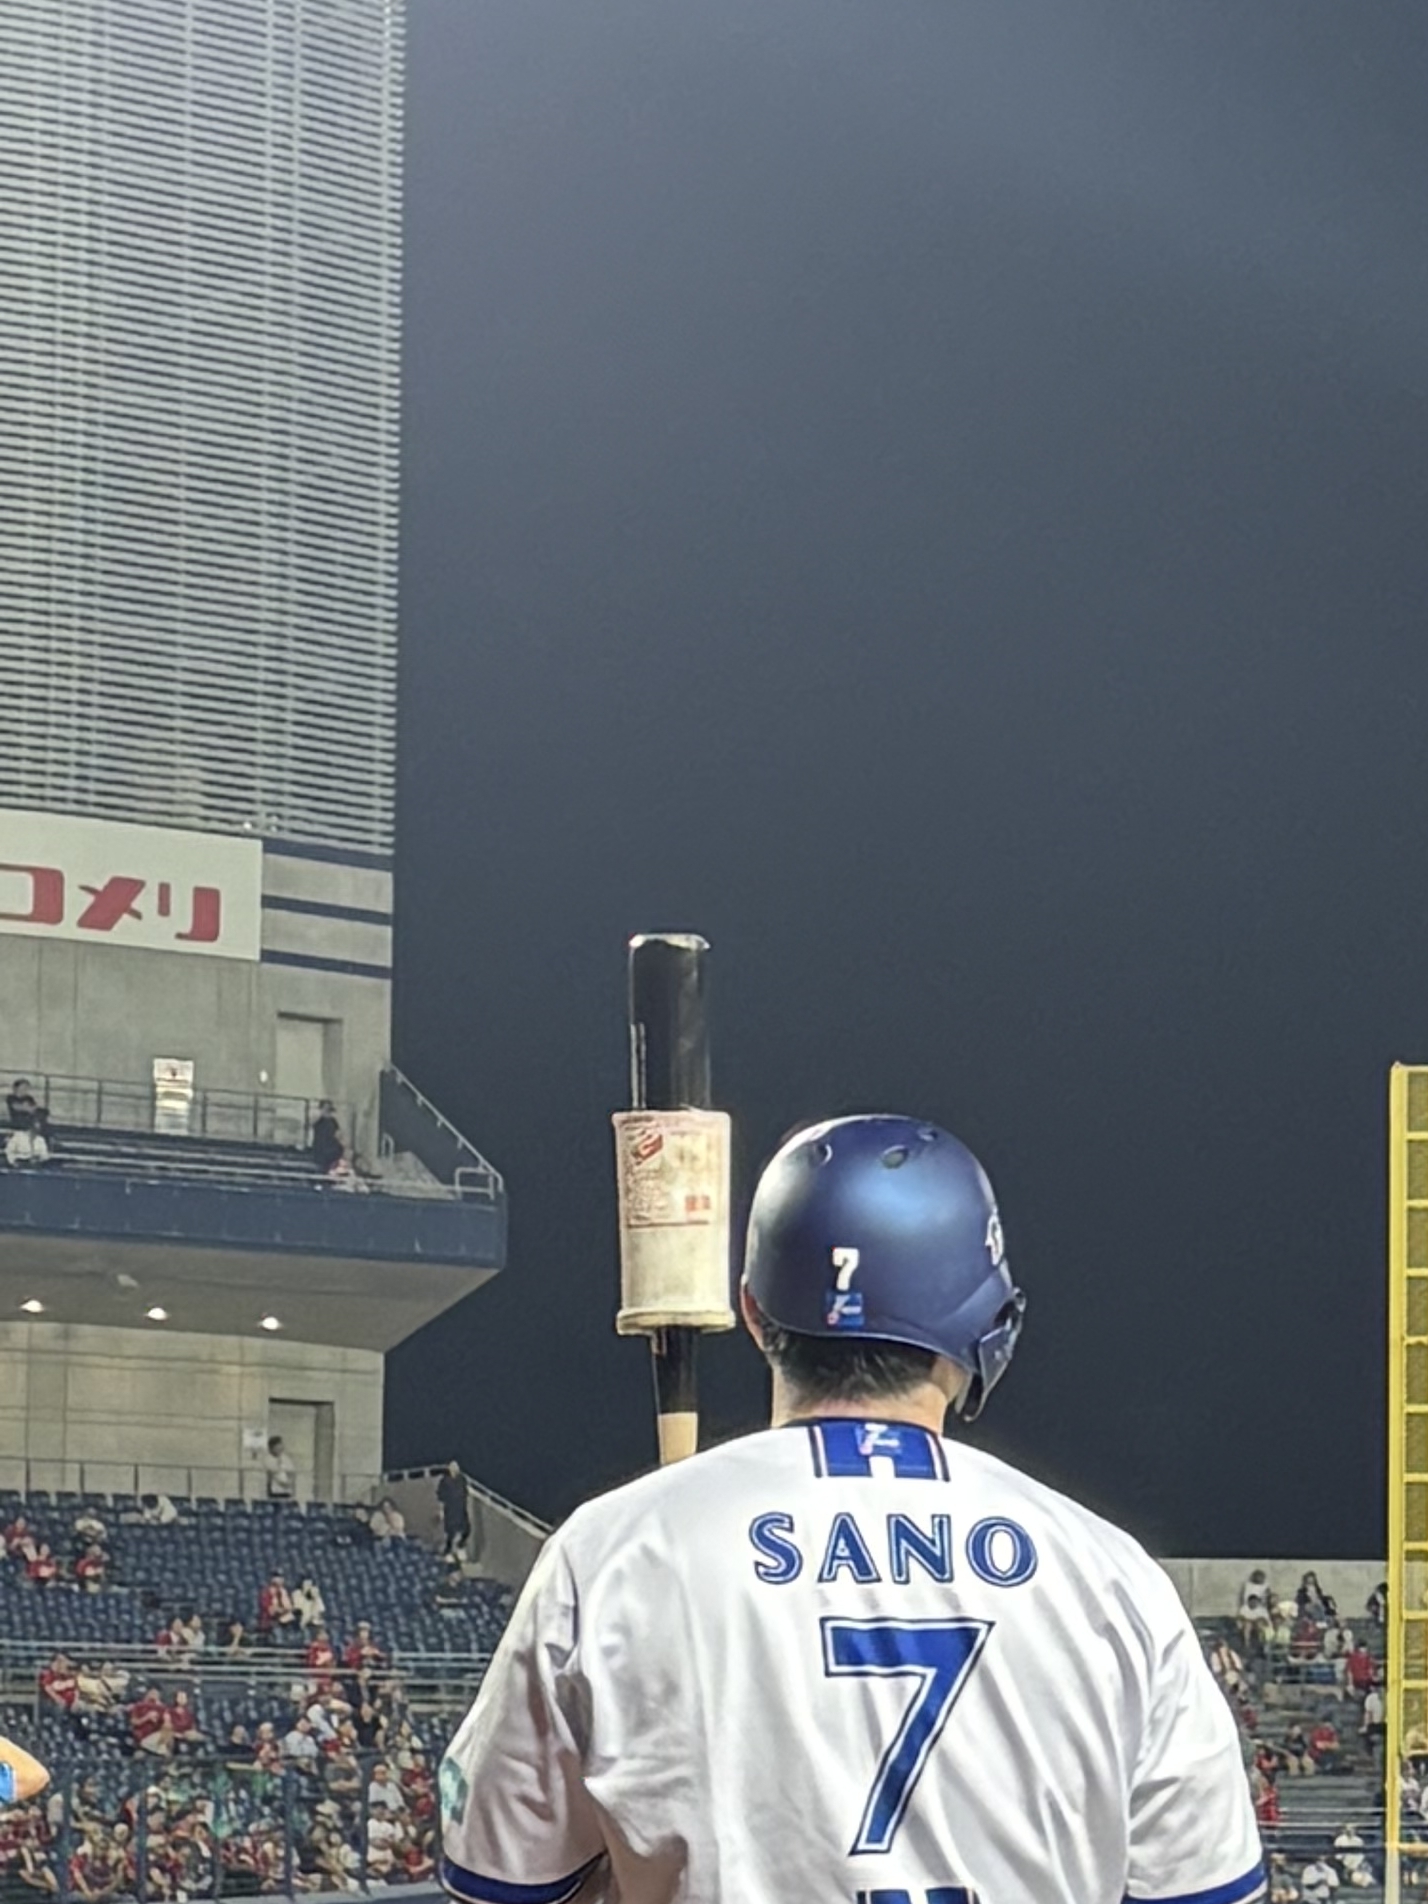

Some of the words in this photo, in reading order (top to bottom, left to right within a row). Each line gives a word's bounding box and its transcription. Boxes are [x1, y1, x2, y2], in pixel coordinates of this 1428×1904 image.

[832, 1247, 859, 1291] 7
[749, 1512, 1038, 1586] SANO
[819, 1615, 996, 1856] 7
